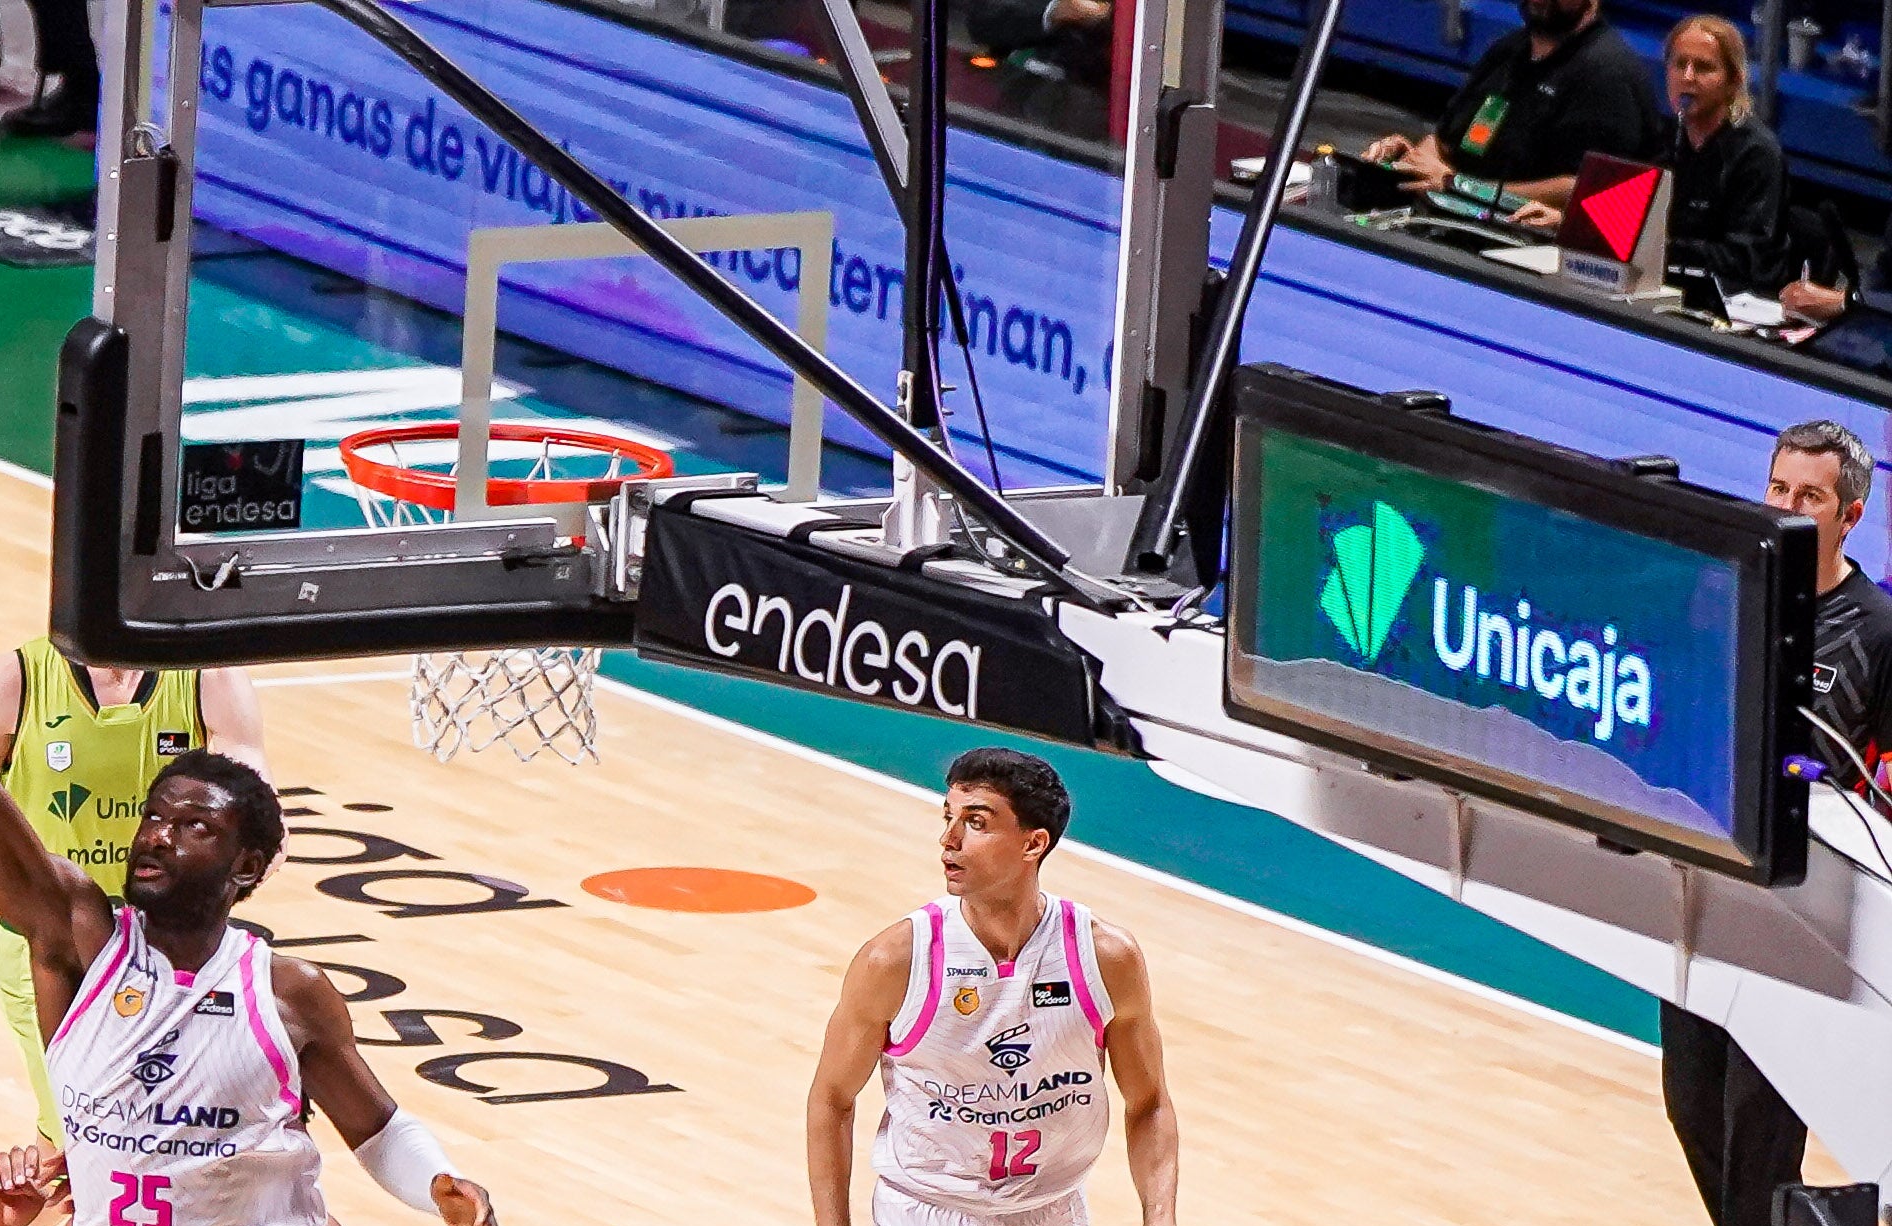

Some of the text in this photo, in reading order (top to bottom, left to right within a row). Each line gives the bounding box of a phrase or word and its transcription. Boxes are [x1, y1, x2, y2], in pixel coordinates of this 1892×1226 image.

[245, 58, 393, 160] ganas
[406, 97, 465, 181] de
[186, 471, 237, 500] liga
[185, 497, 296, 526] endesa
[704, 582, 982, 720] endesa
[1432, 576, 1653, 742] Unicaja
[61, 1083, 241, 1130] DREAMLAND
[924, 1071, 1093, 1105] DREAMLAND
[957, 1089, 1092, 1126] GranCanaria
[82, 1124, 237, 1159] GranCanaria
[988, 1129, 1042, 1181] 12
